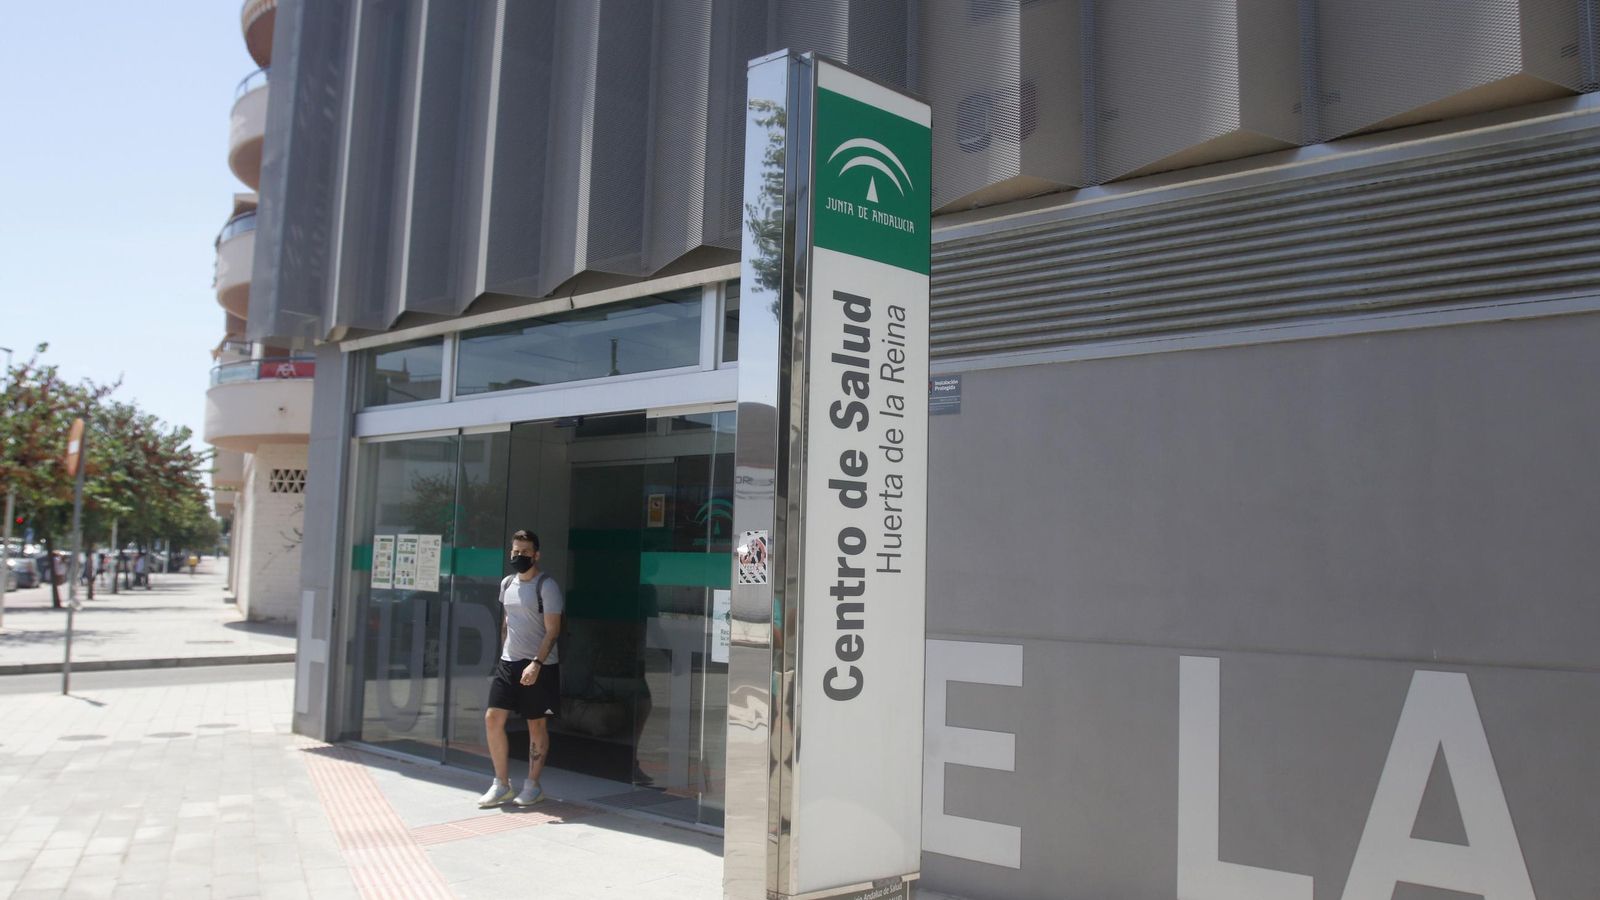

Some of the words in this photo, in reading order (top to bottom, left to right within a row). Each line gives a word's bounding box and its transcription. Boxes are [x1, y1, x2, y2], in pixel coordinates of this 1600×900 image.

[826, 197, 854, 216] JUNTA
[858, 205, 868, 220] DE
[829, 290, 871, 432] Salud
[880, 304, 906, 383] Reina
[879, 394, 905, 418] la
[879, 428, 904, 463] de
[828, 449, 868, 509] de
[876, 474, 903, 573] Huerta
[822, 526, 867, 701] Centro
[1177, 655, 1537, 900] LA
